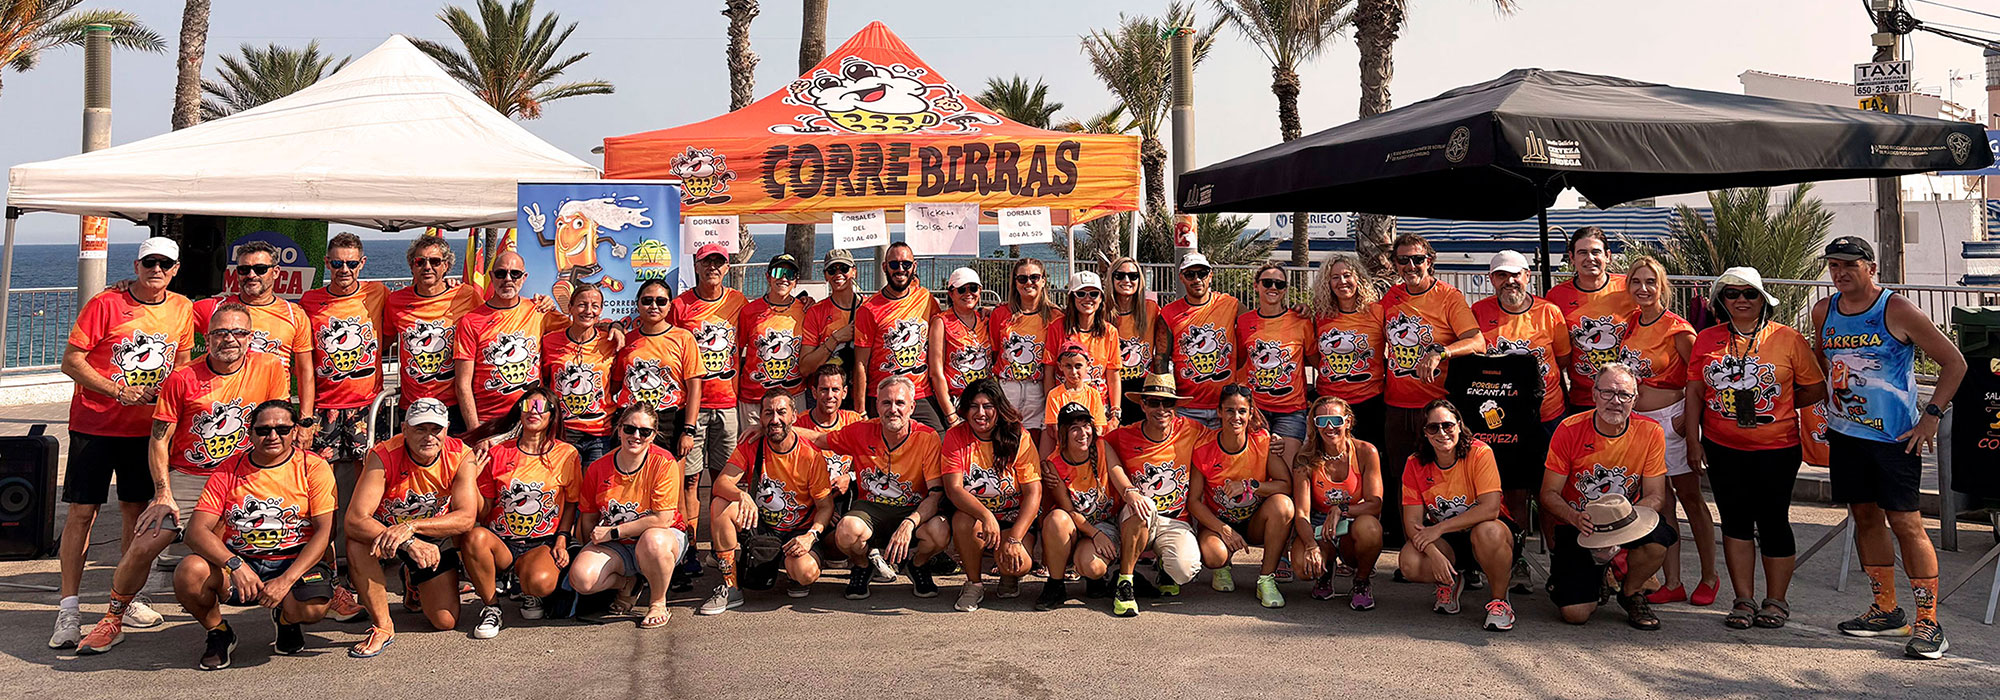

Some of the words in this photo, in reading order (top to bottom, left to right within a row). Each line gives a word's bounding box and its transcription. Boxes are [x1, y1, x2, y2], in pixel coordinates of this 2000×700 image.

[1858, 63, 1906, 77] TAXI
[760, 142, 911, 199] CORRE
[916, 140, 1080, 198] BIRRAS
[841, 213, 876, 221] DORSALES
[636, 268, 666, 282] 2025
[1823, 333, 1882, 348] ARRERA
[1471, 381, 1500, 389] PORQUE
[1466, 388, 1506, 396] ENCANTA
[1848, 406, 1866, 415] DEL
[1473, 432, 1518, 443] CERVEZA
